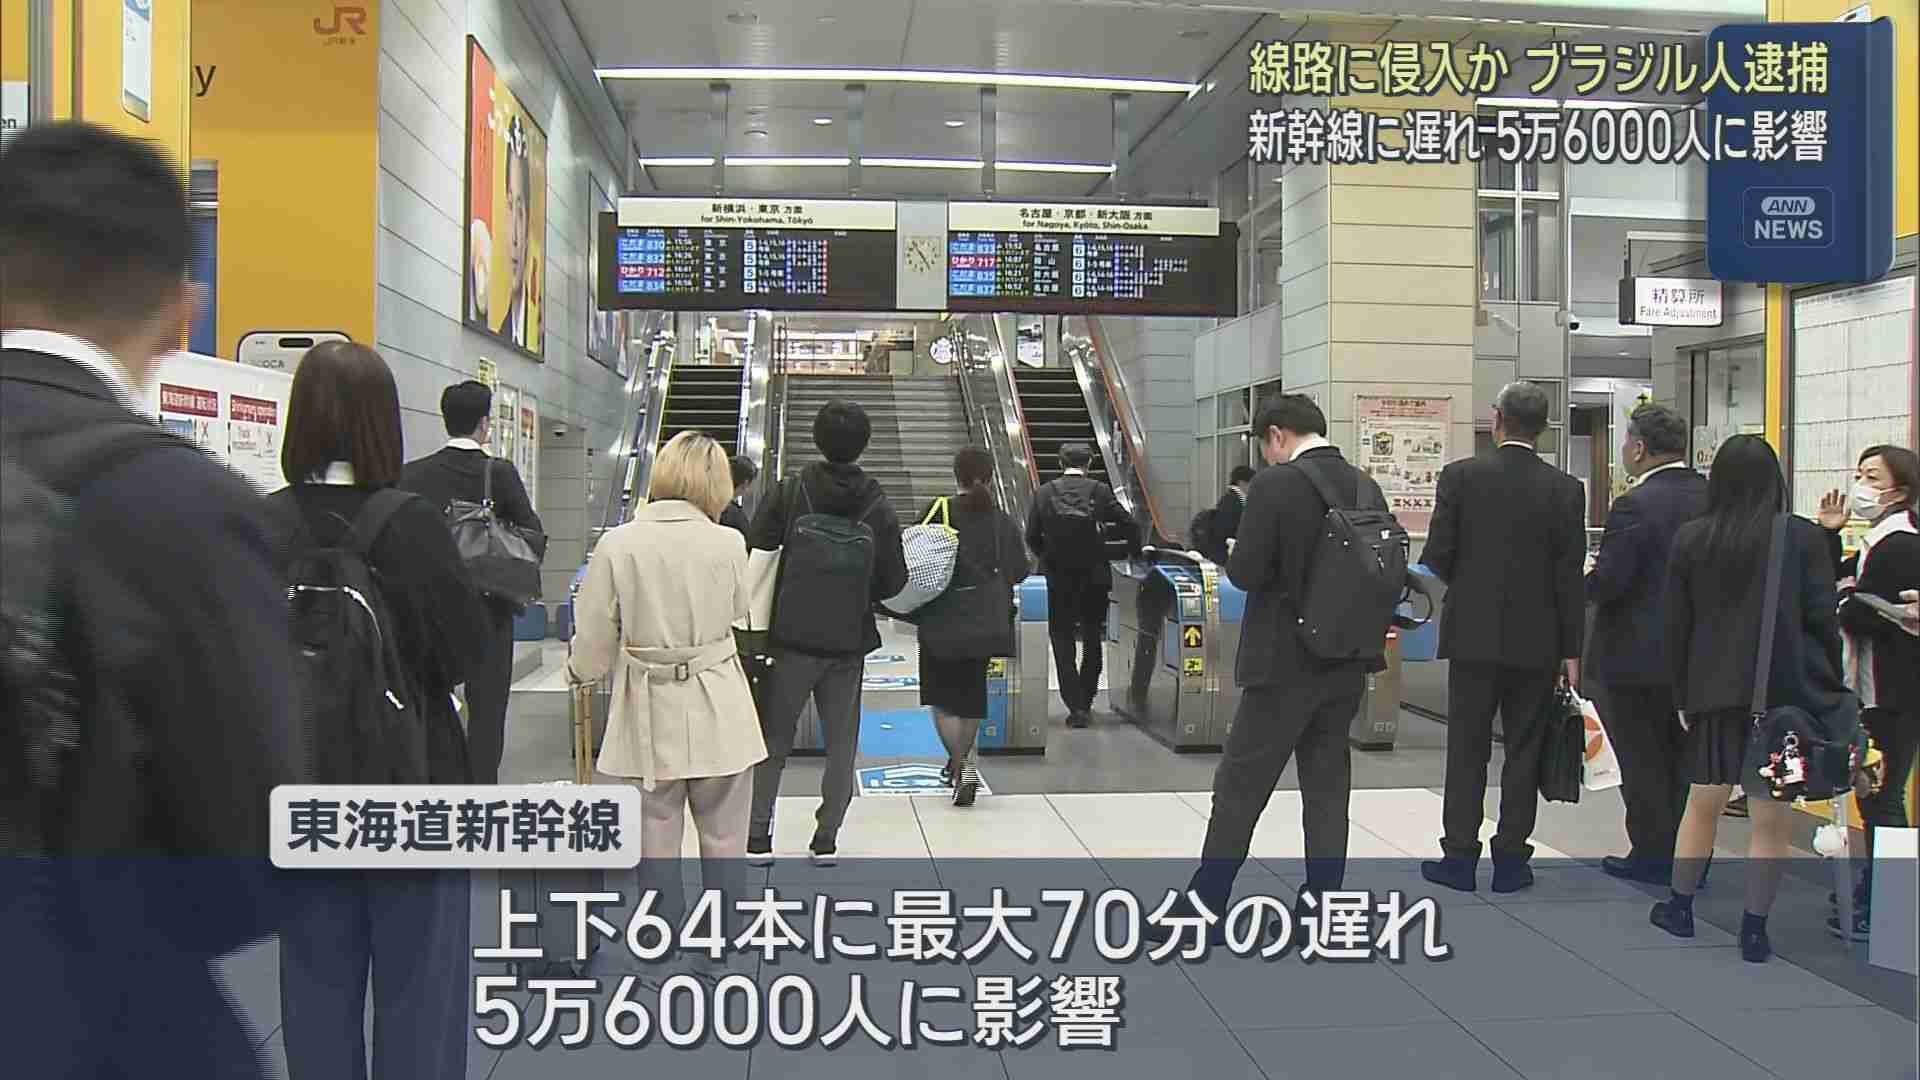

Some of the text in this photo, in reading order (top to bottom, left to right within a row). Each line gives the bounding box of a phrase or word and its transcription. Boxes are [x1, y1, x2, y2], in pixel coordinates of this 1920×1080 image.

[313, 7, 367, 35] JR
[191, 64, 217, 97] y
[701, 215, 713, 223] for
[1023, 219, 1035, 228] for
[951, 256, 976, 264] ひかり
[977, 257, 996, 267] 717
[646, 267, 665, 276] 712
[1653, 288, 1704, 305] 精算所
[1640, 305, 1659, 317] Fare
